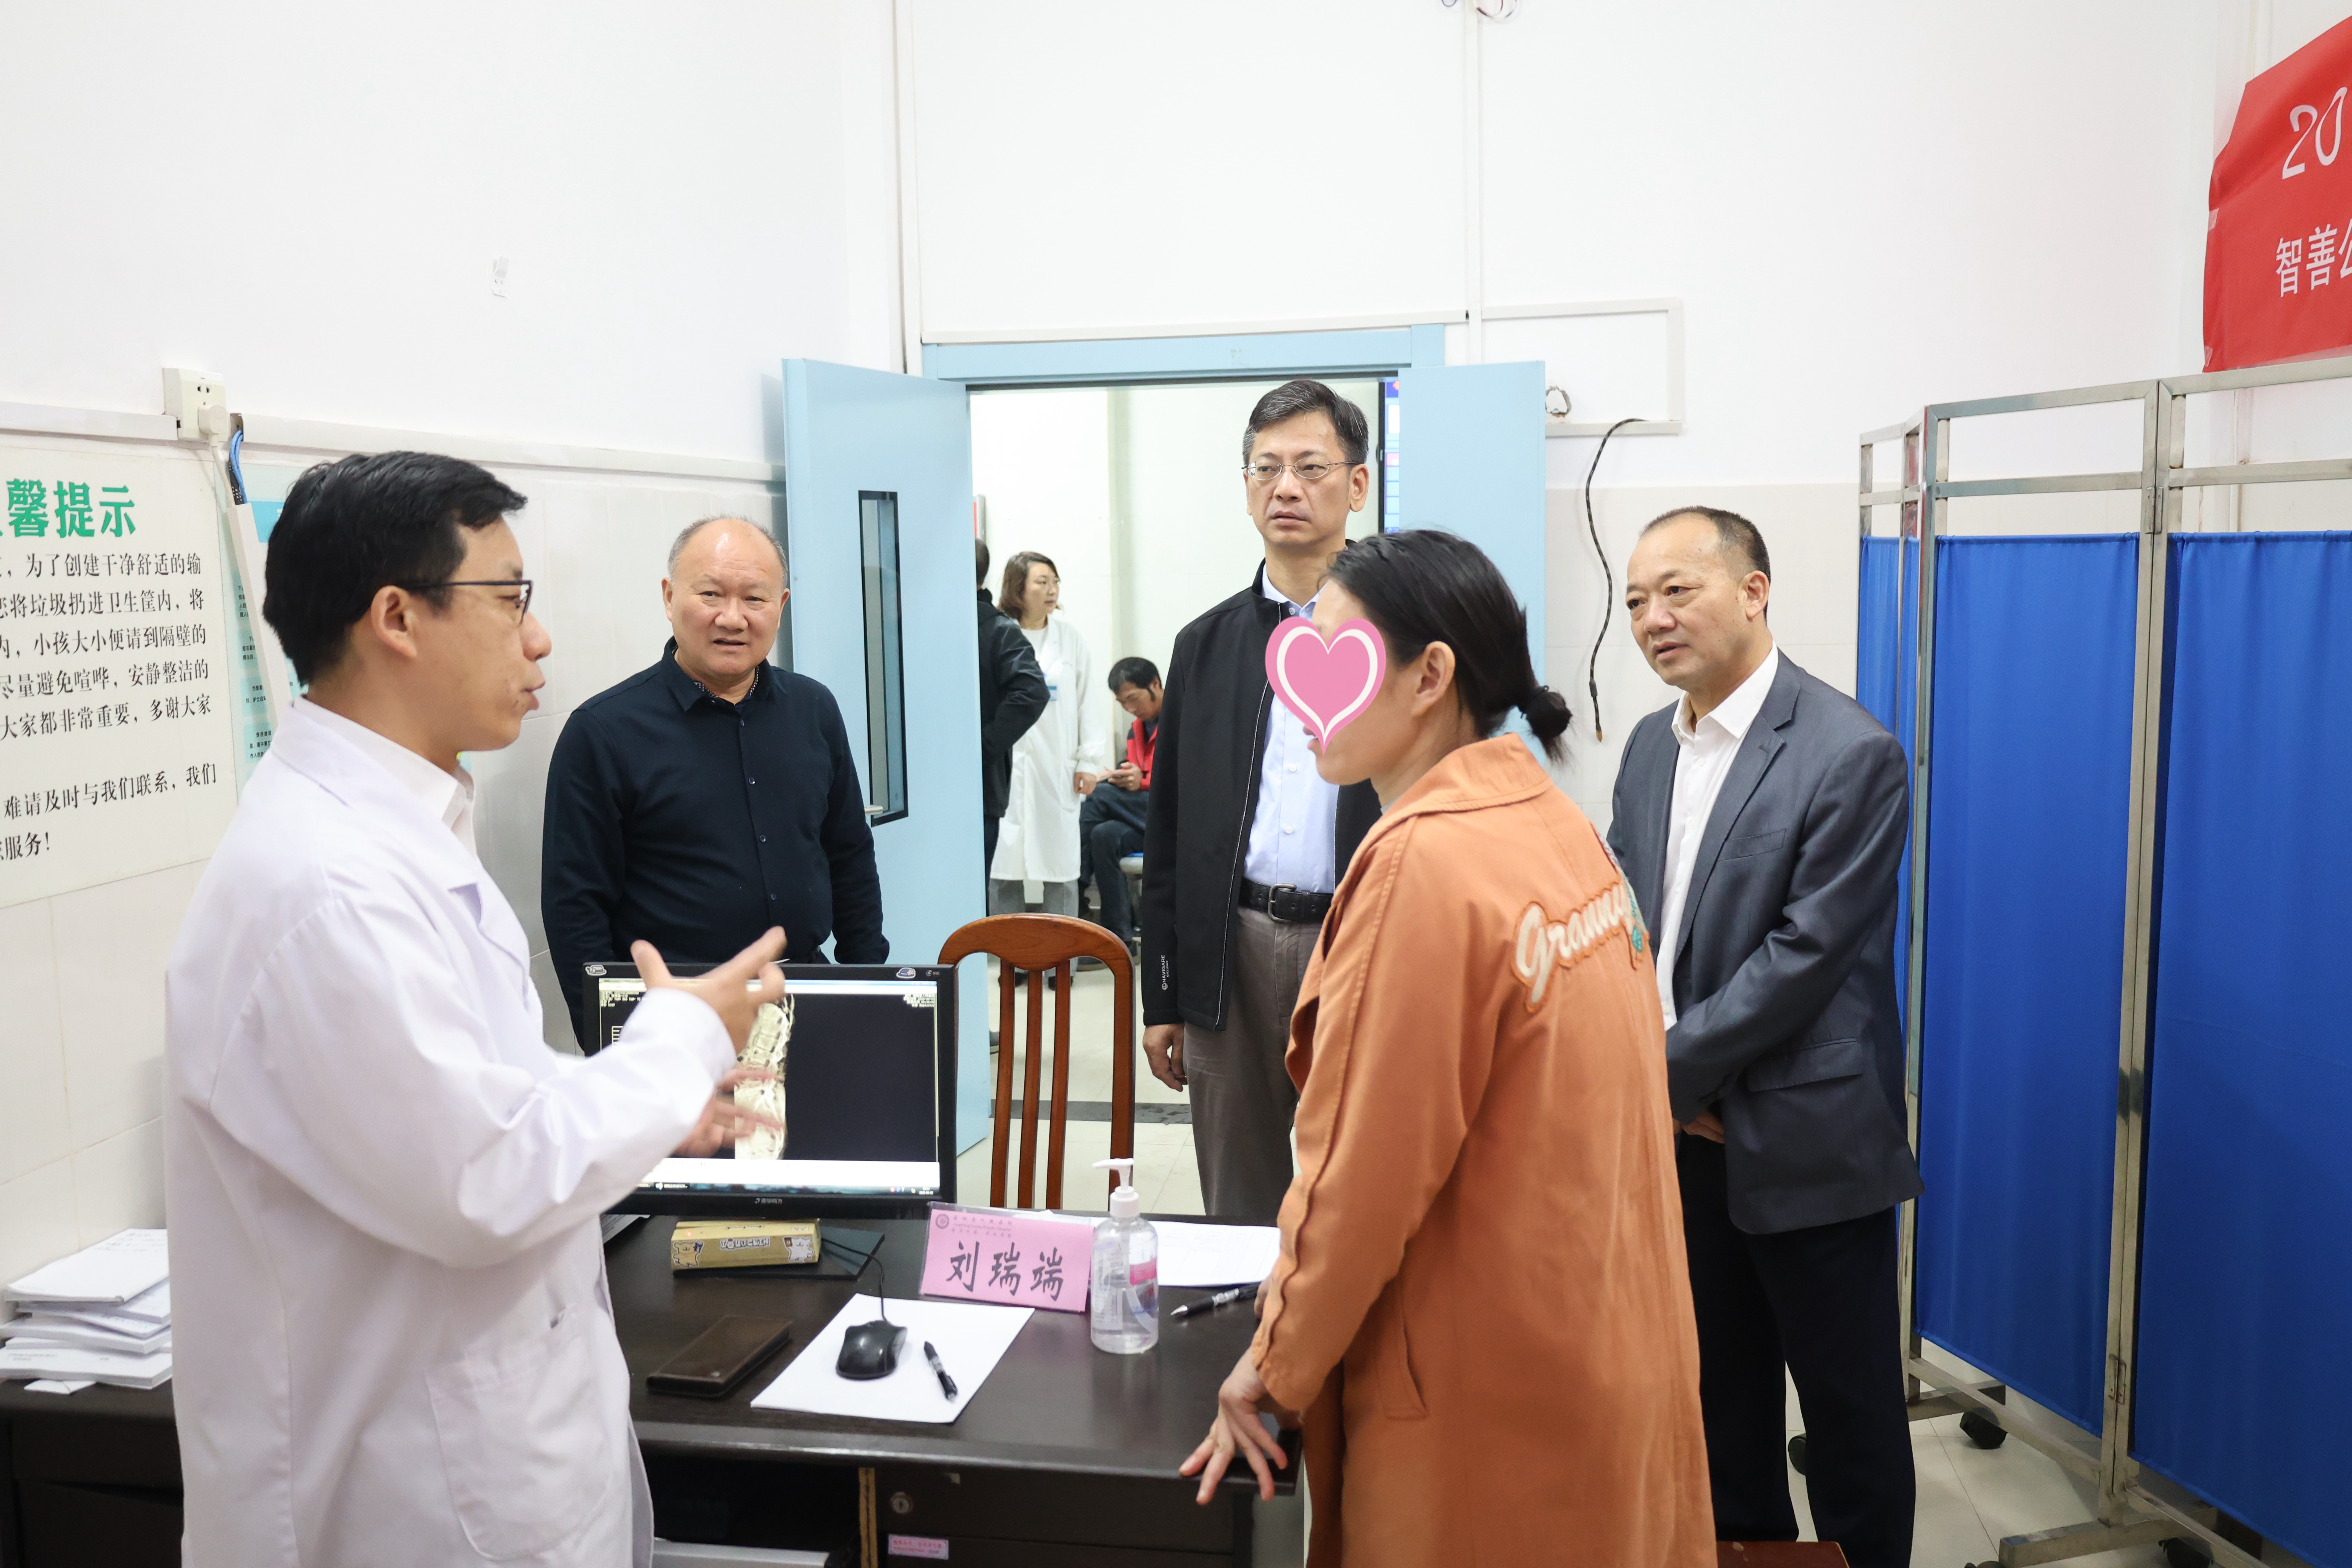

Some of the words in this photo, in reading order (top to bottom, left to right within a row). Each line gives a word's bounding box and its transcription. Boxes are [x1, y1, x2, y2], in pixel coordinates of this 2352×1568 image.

[2282, 86, 2348, 180] 20
[0, 478, 136, 538] 馨提示
[0, 552, 201, 578] ，为了创建干净舒适的输
[0, 693, 211, 741] 大家都非常重要，多谢大家
[3, 763, 216, 820] 难请及时与我们联系，我们
[0, 831, 50, 861] 服务！
[946, 1241, 1063, 1302] 刘瑞端
